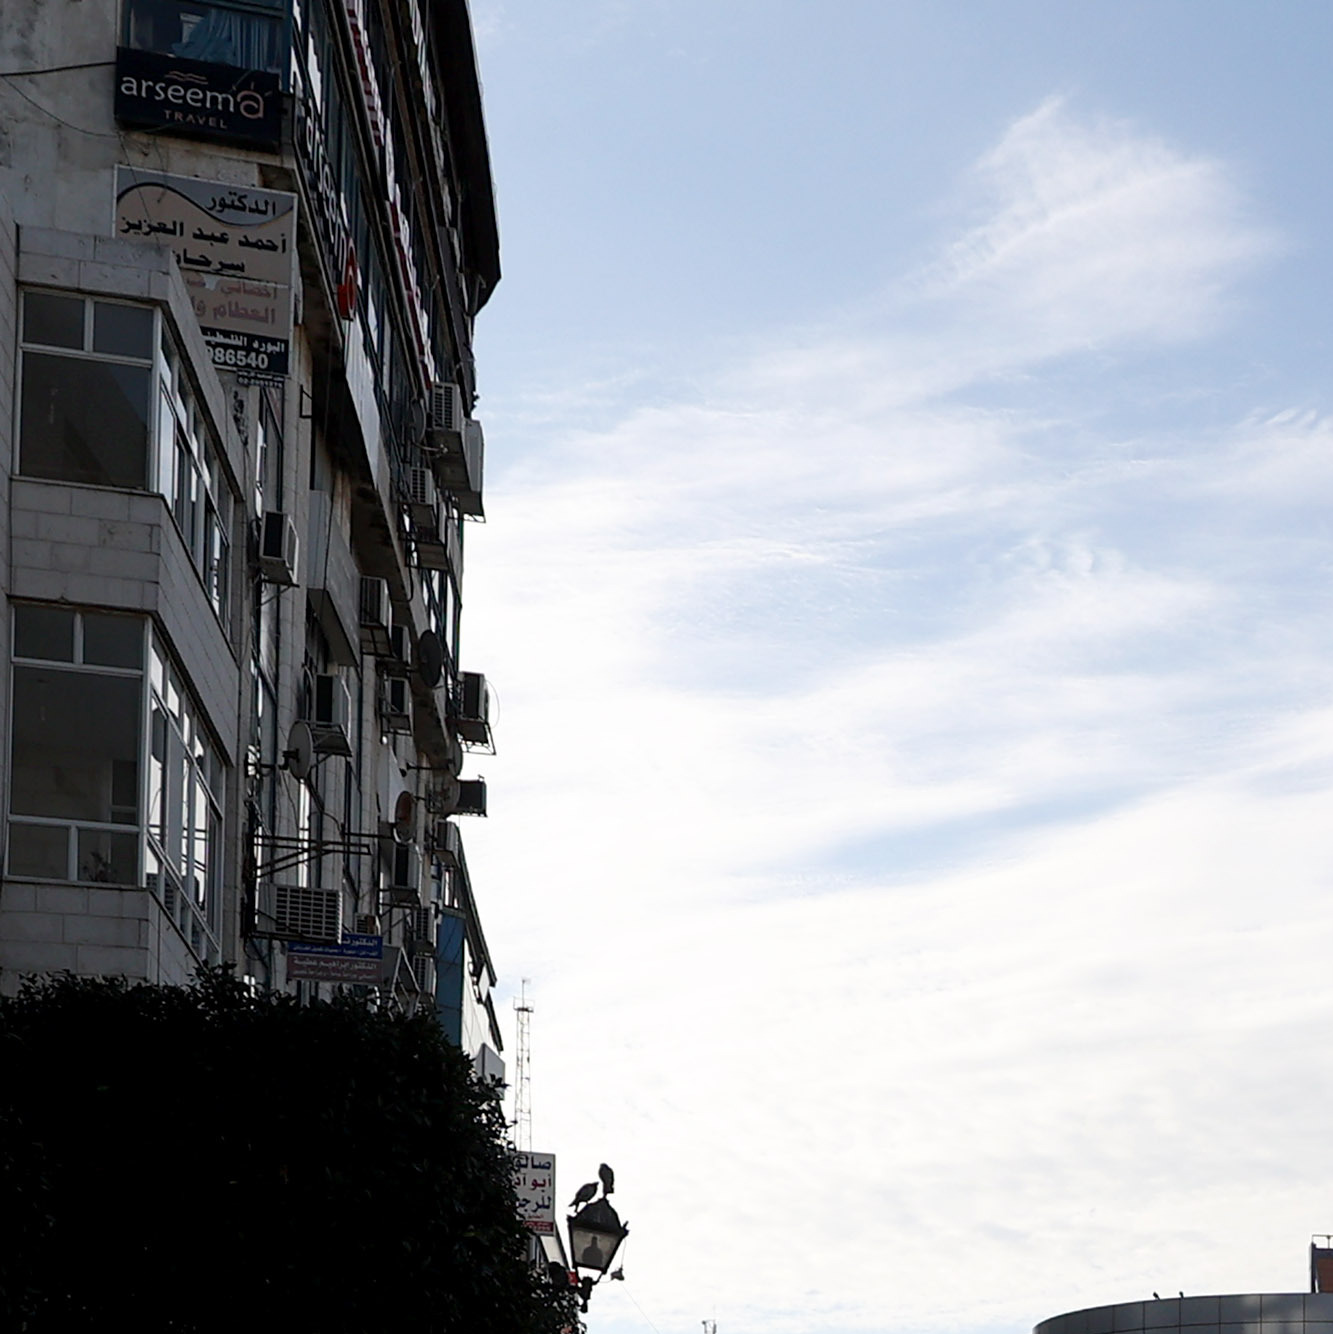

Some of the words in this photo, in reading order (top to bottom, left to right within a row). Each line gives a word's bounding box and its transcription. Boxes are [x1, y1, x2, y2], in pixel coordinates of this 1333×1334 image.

[119, 75, 265, 119] arseema
[163, 108, 229, 130] TRAVEL
[207, 191, 277, 216] الدكتور
[120, 216, 185, 236] العزيز
[193, 227, 230, 246] عبد
[238, 233, 287, 253] أحمد
